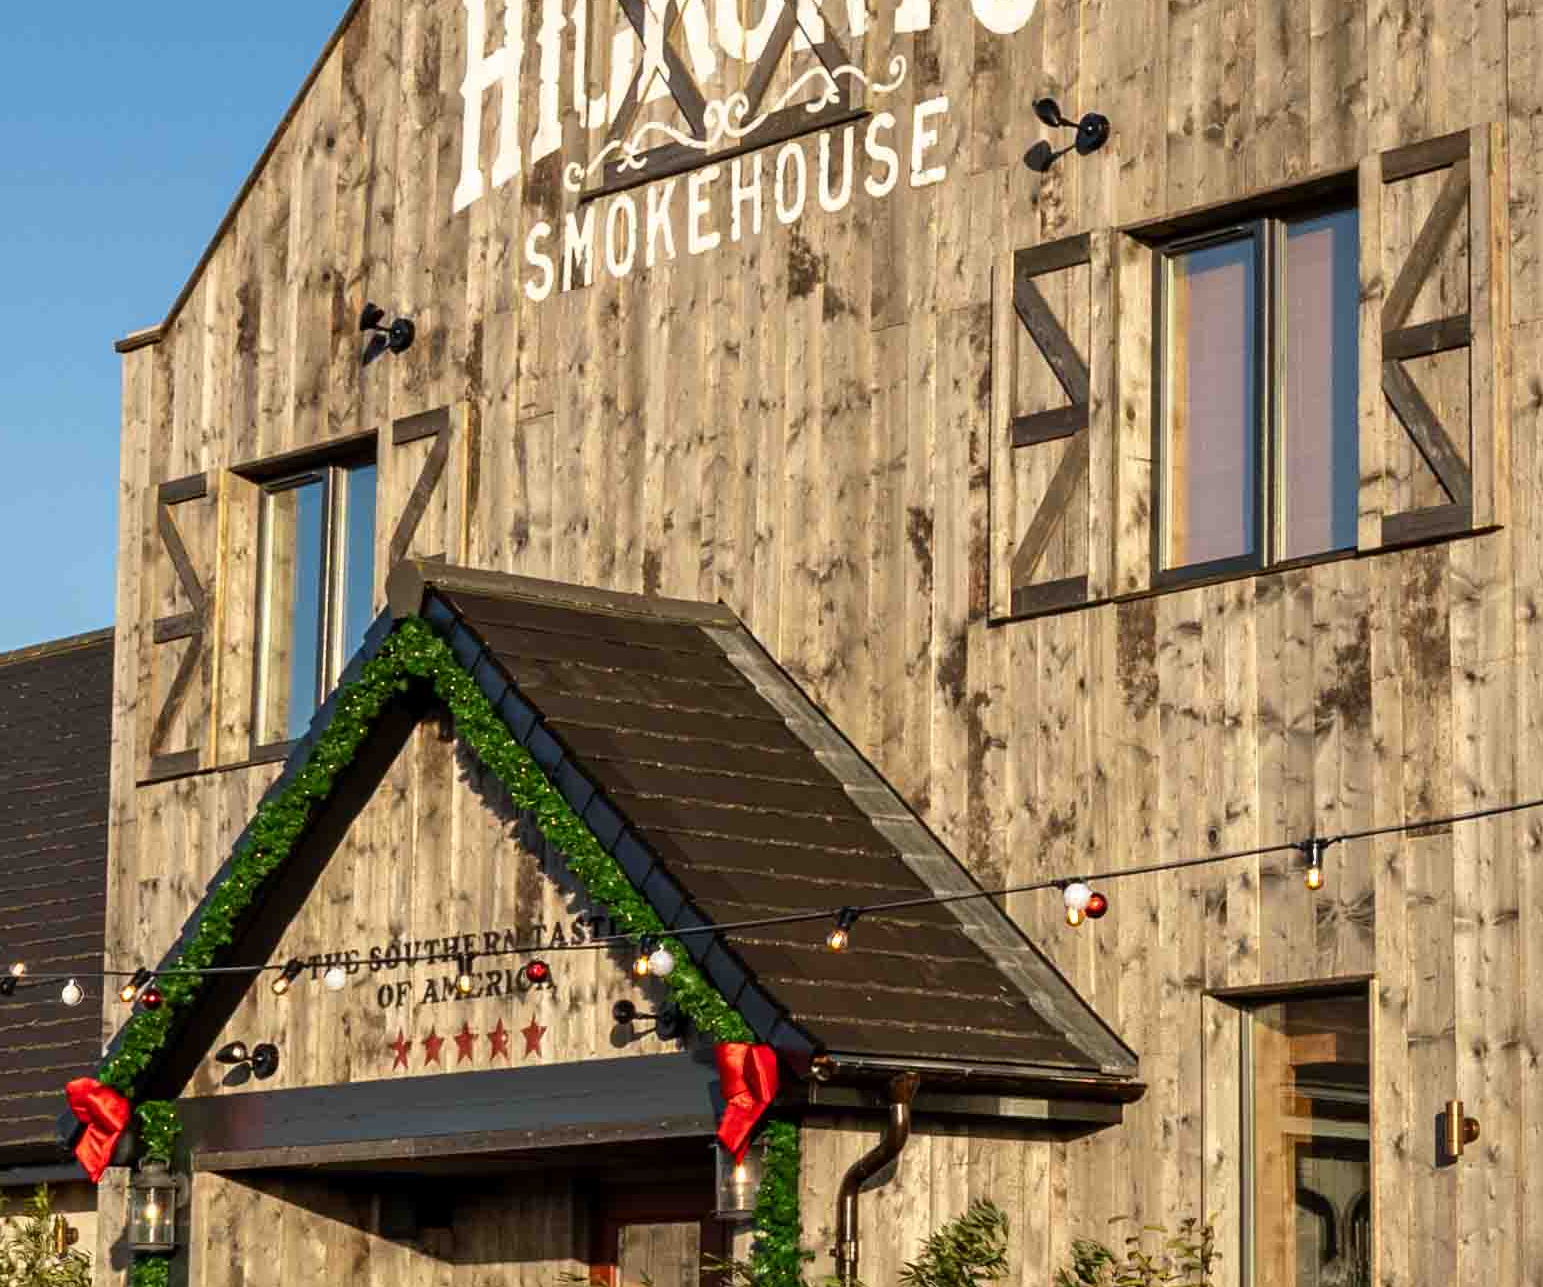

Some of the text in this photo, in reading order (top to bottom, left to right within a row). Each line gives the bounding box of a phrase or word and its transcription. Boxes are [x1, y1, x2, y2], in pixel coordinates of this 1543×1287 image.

[524, 96, 950, 301] SMOKEHOUSE
[368, 926, 521, 973] SOUTHERN
[376, 980, 412, 1009] OF
